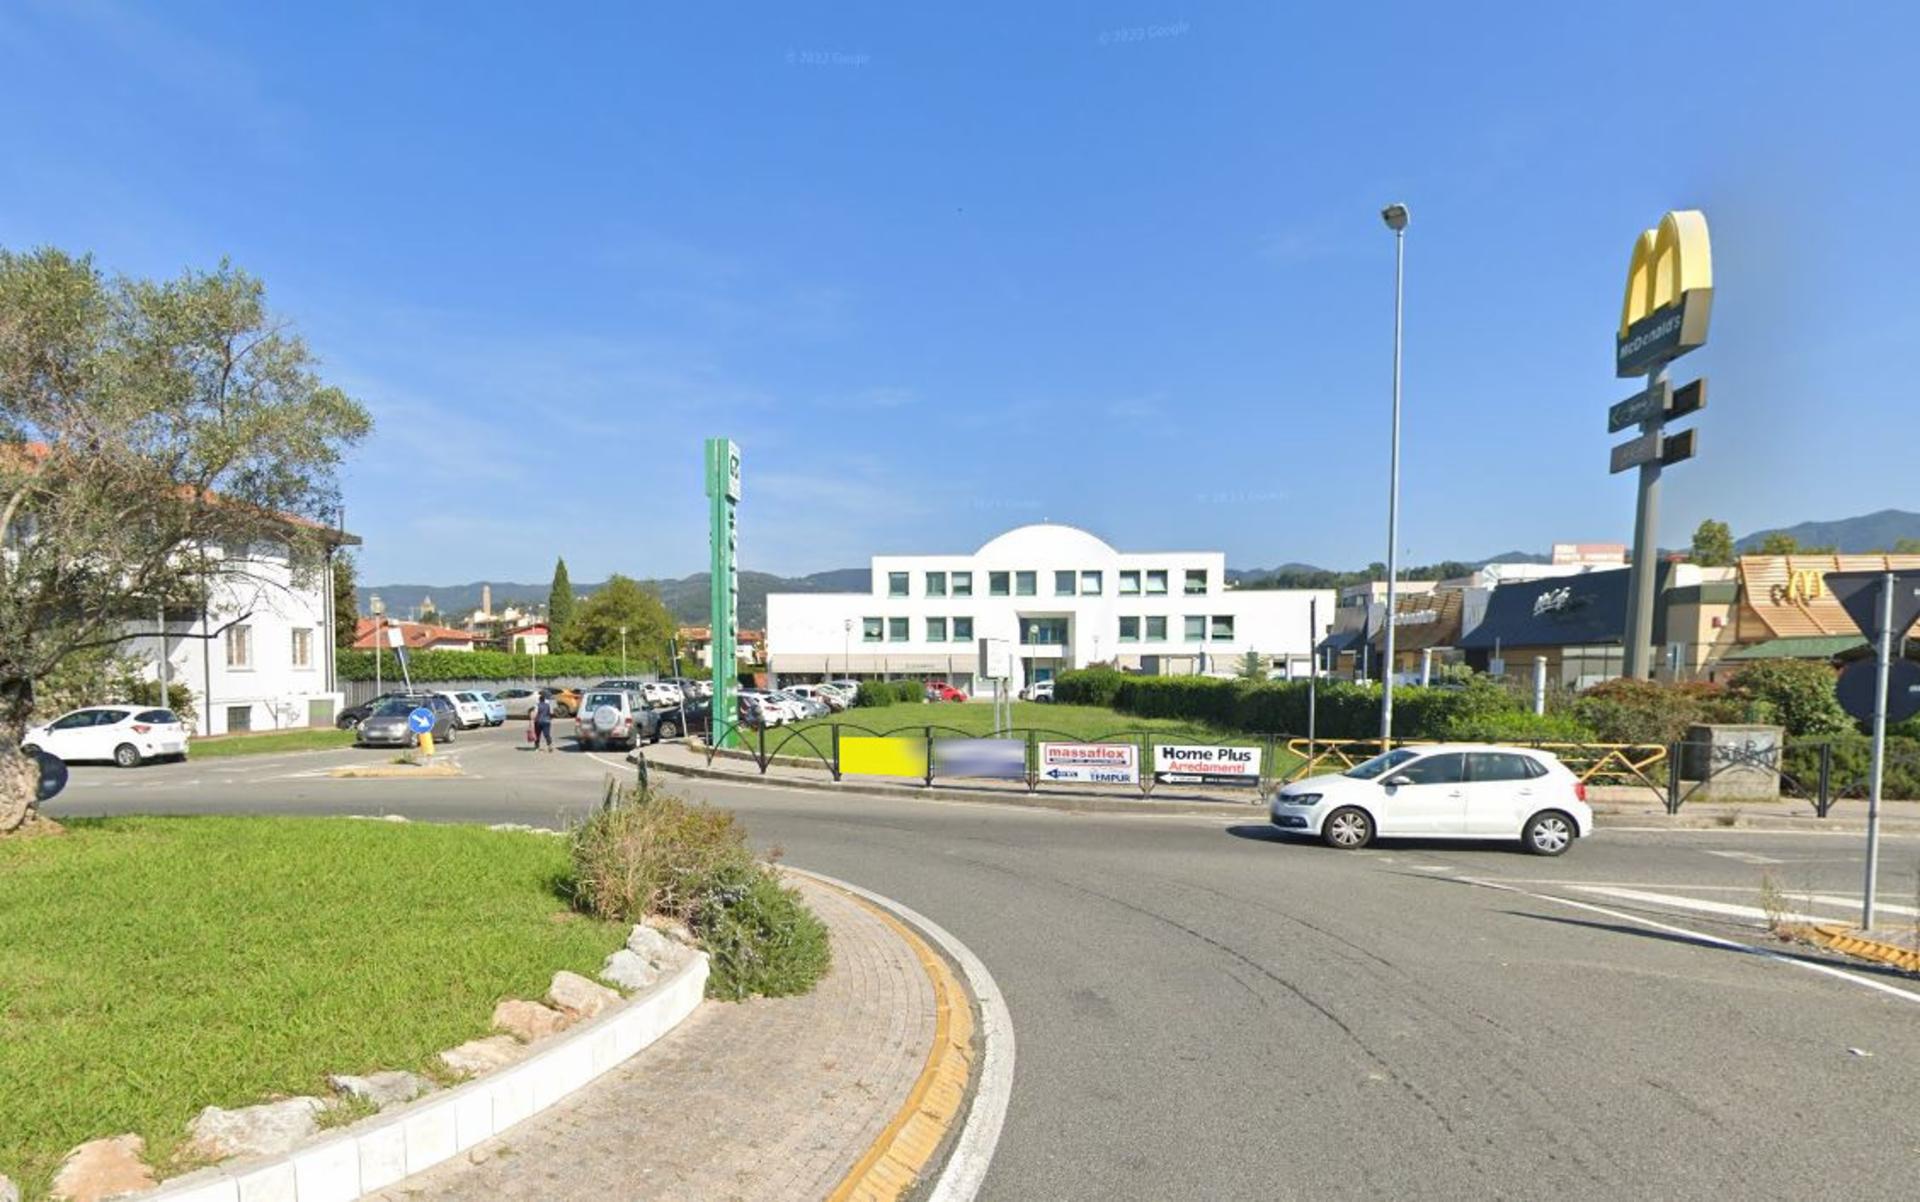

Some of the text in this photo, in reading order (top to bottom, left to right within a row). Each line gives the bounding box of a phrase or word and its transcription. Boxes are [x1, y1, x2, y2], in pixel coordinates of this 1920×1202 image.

[1619, 314, 1682, 360] McDonald's
[1162, 747, 1252, 762] Home Plus
[1168, 761, 1246, 774] Arredamenti
[1090, 773, 1131, 782] TEMPUR
